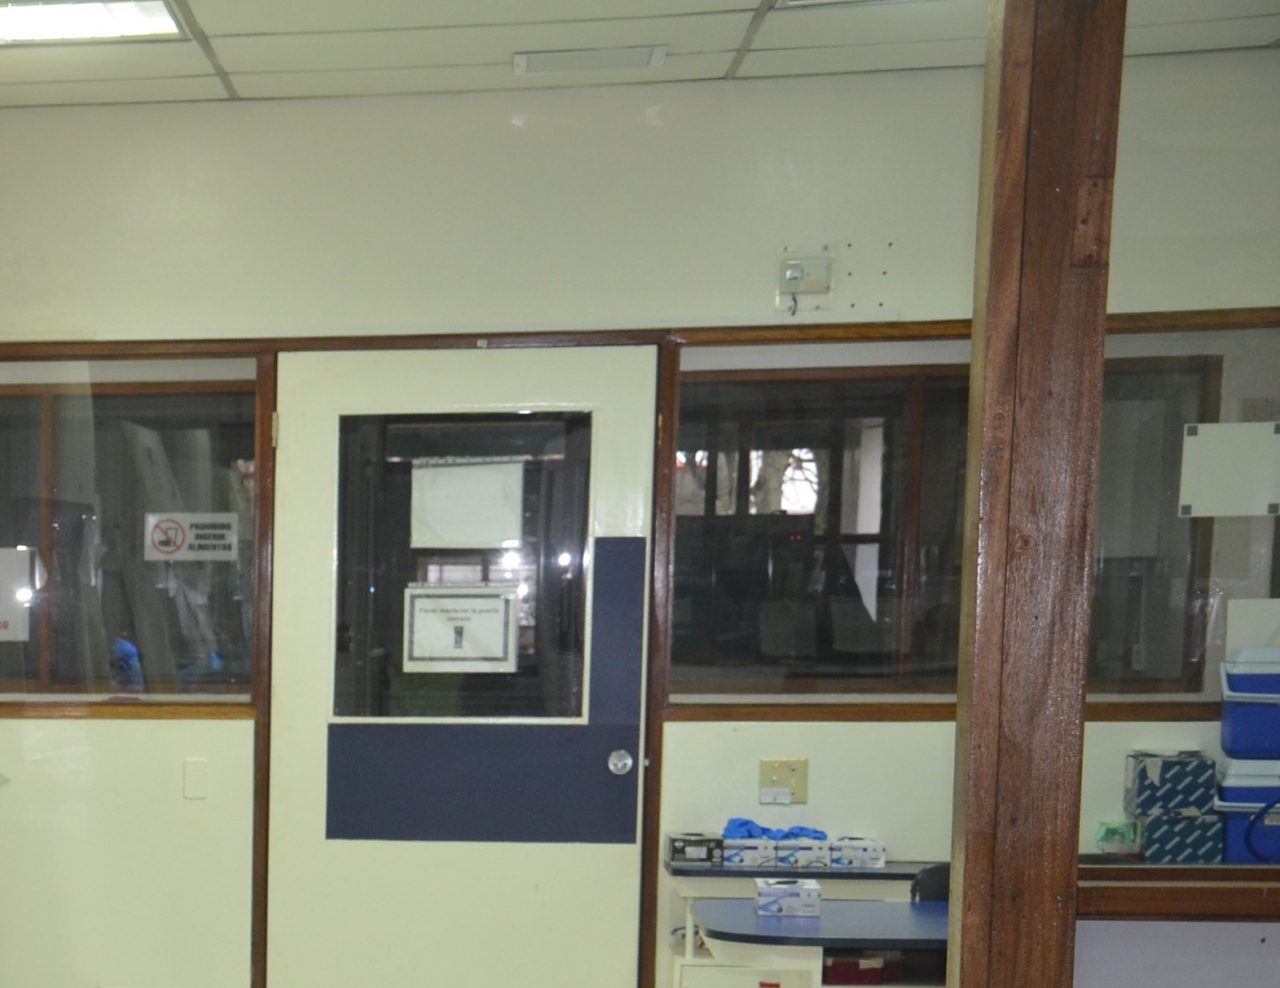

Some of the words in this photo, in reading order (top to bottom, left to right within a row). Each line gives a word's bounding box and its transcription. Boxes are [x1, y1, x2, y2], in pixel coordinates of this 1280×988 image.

[189, 522, 232, 531] PROHIBIDO
[194, 533, 226, 541] INGERIR
[187, 543, 233, 551] ALIMENTOS
[478, 607, 499, 615] puerta
